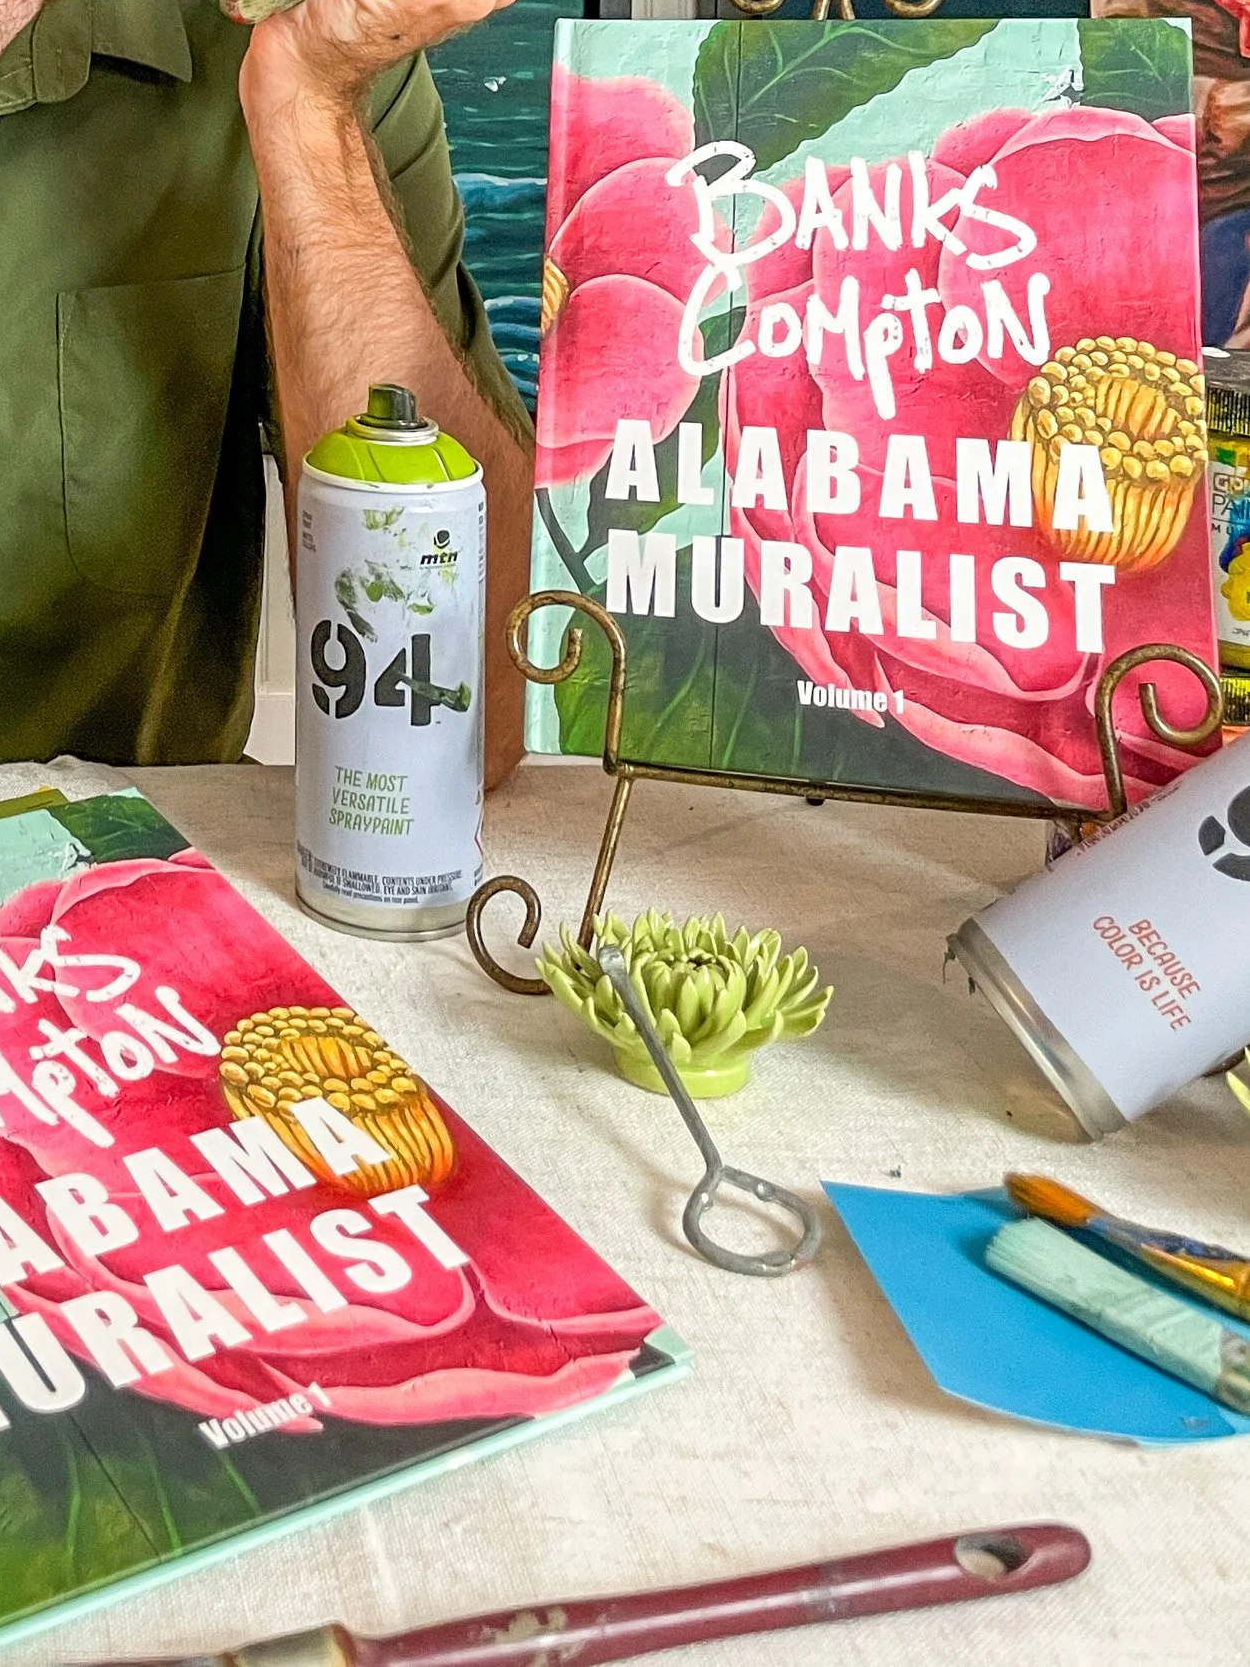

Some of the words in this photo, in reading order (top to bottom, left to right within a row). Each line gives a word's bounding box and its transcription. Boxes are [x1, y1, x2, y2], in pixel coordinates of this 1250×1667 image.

[604, 419, 1115, 533] ALABAMA
[604, 530, 1117, 654] MURALIST
[311, 619, 443, 727] 94
[797, 679, 888, 713] Volume
[893, 689, 905, 713] 1
[332, 787, 410, 814] VERSATILE
[334, 765, 362, 787] THE
[366, 773, 408, 792] MOST
[329, 808, 414, 835] SPRAYPAINT
[1093, 915, 1145, 971] COLOR
[1134, 969, 1161, 993] IS
[1151, 992, 1192, 1031] LIFE
[1127, 918, 1202, 1000] BECAUSE
[199, 1390, 314, 1450] Volume
[309, 1381, 332, 1408] 1
